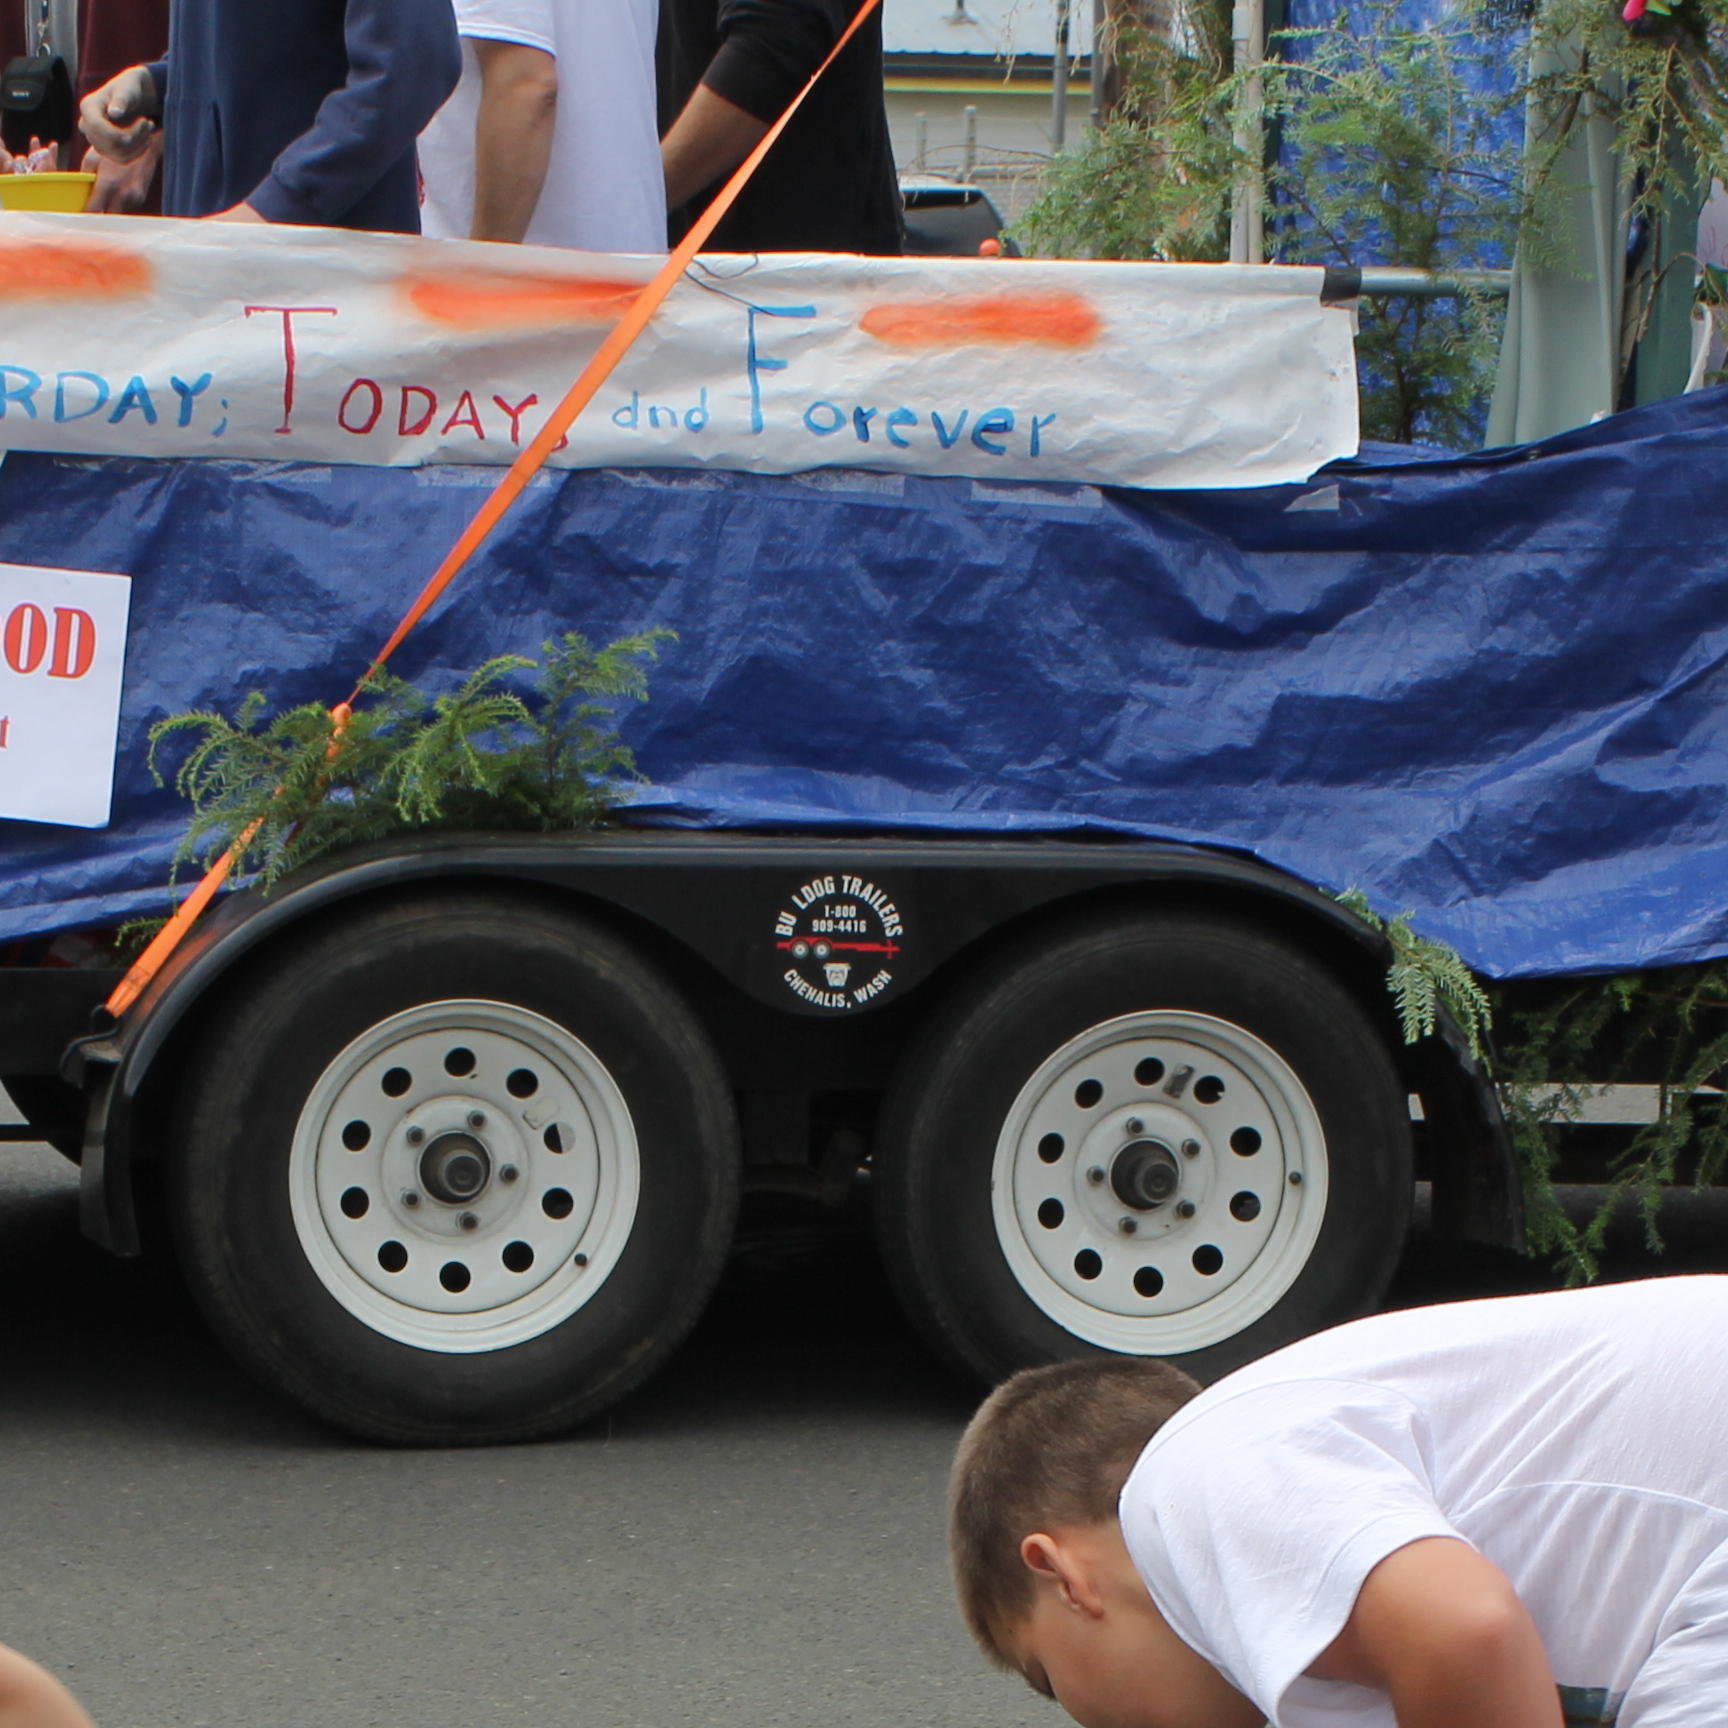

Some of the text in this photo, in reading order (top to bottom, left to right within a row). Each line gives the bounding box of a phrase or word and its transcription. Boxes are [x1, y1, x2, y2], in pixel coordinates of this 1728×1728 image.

[747, 303, 1057, 458] Forever
[824, 905, 857, 918] 1-800
[841, 874, 904, 938] TRAILERS
[812, 919, 867, 933] 909-4416
[853, 969, 892, 1003] WASH
